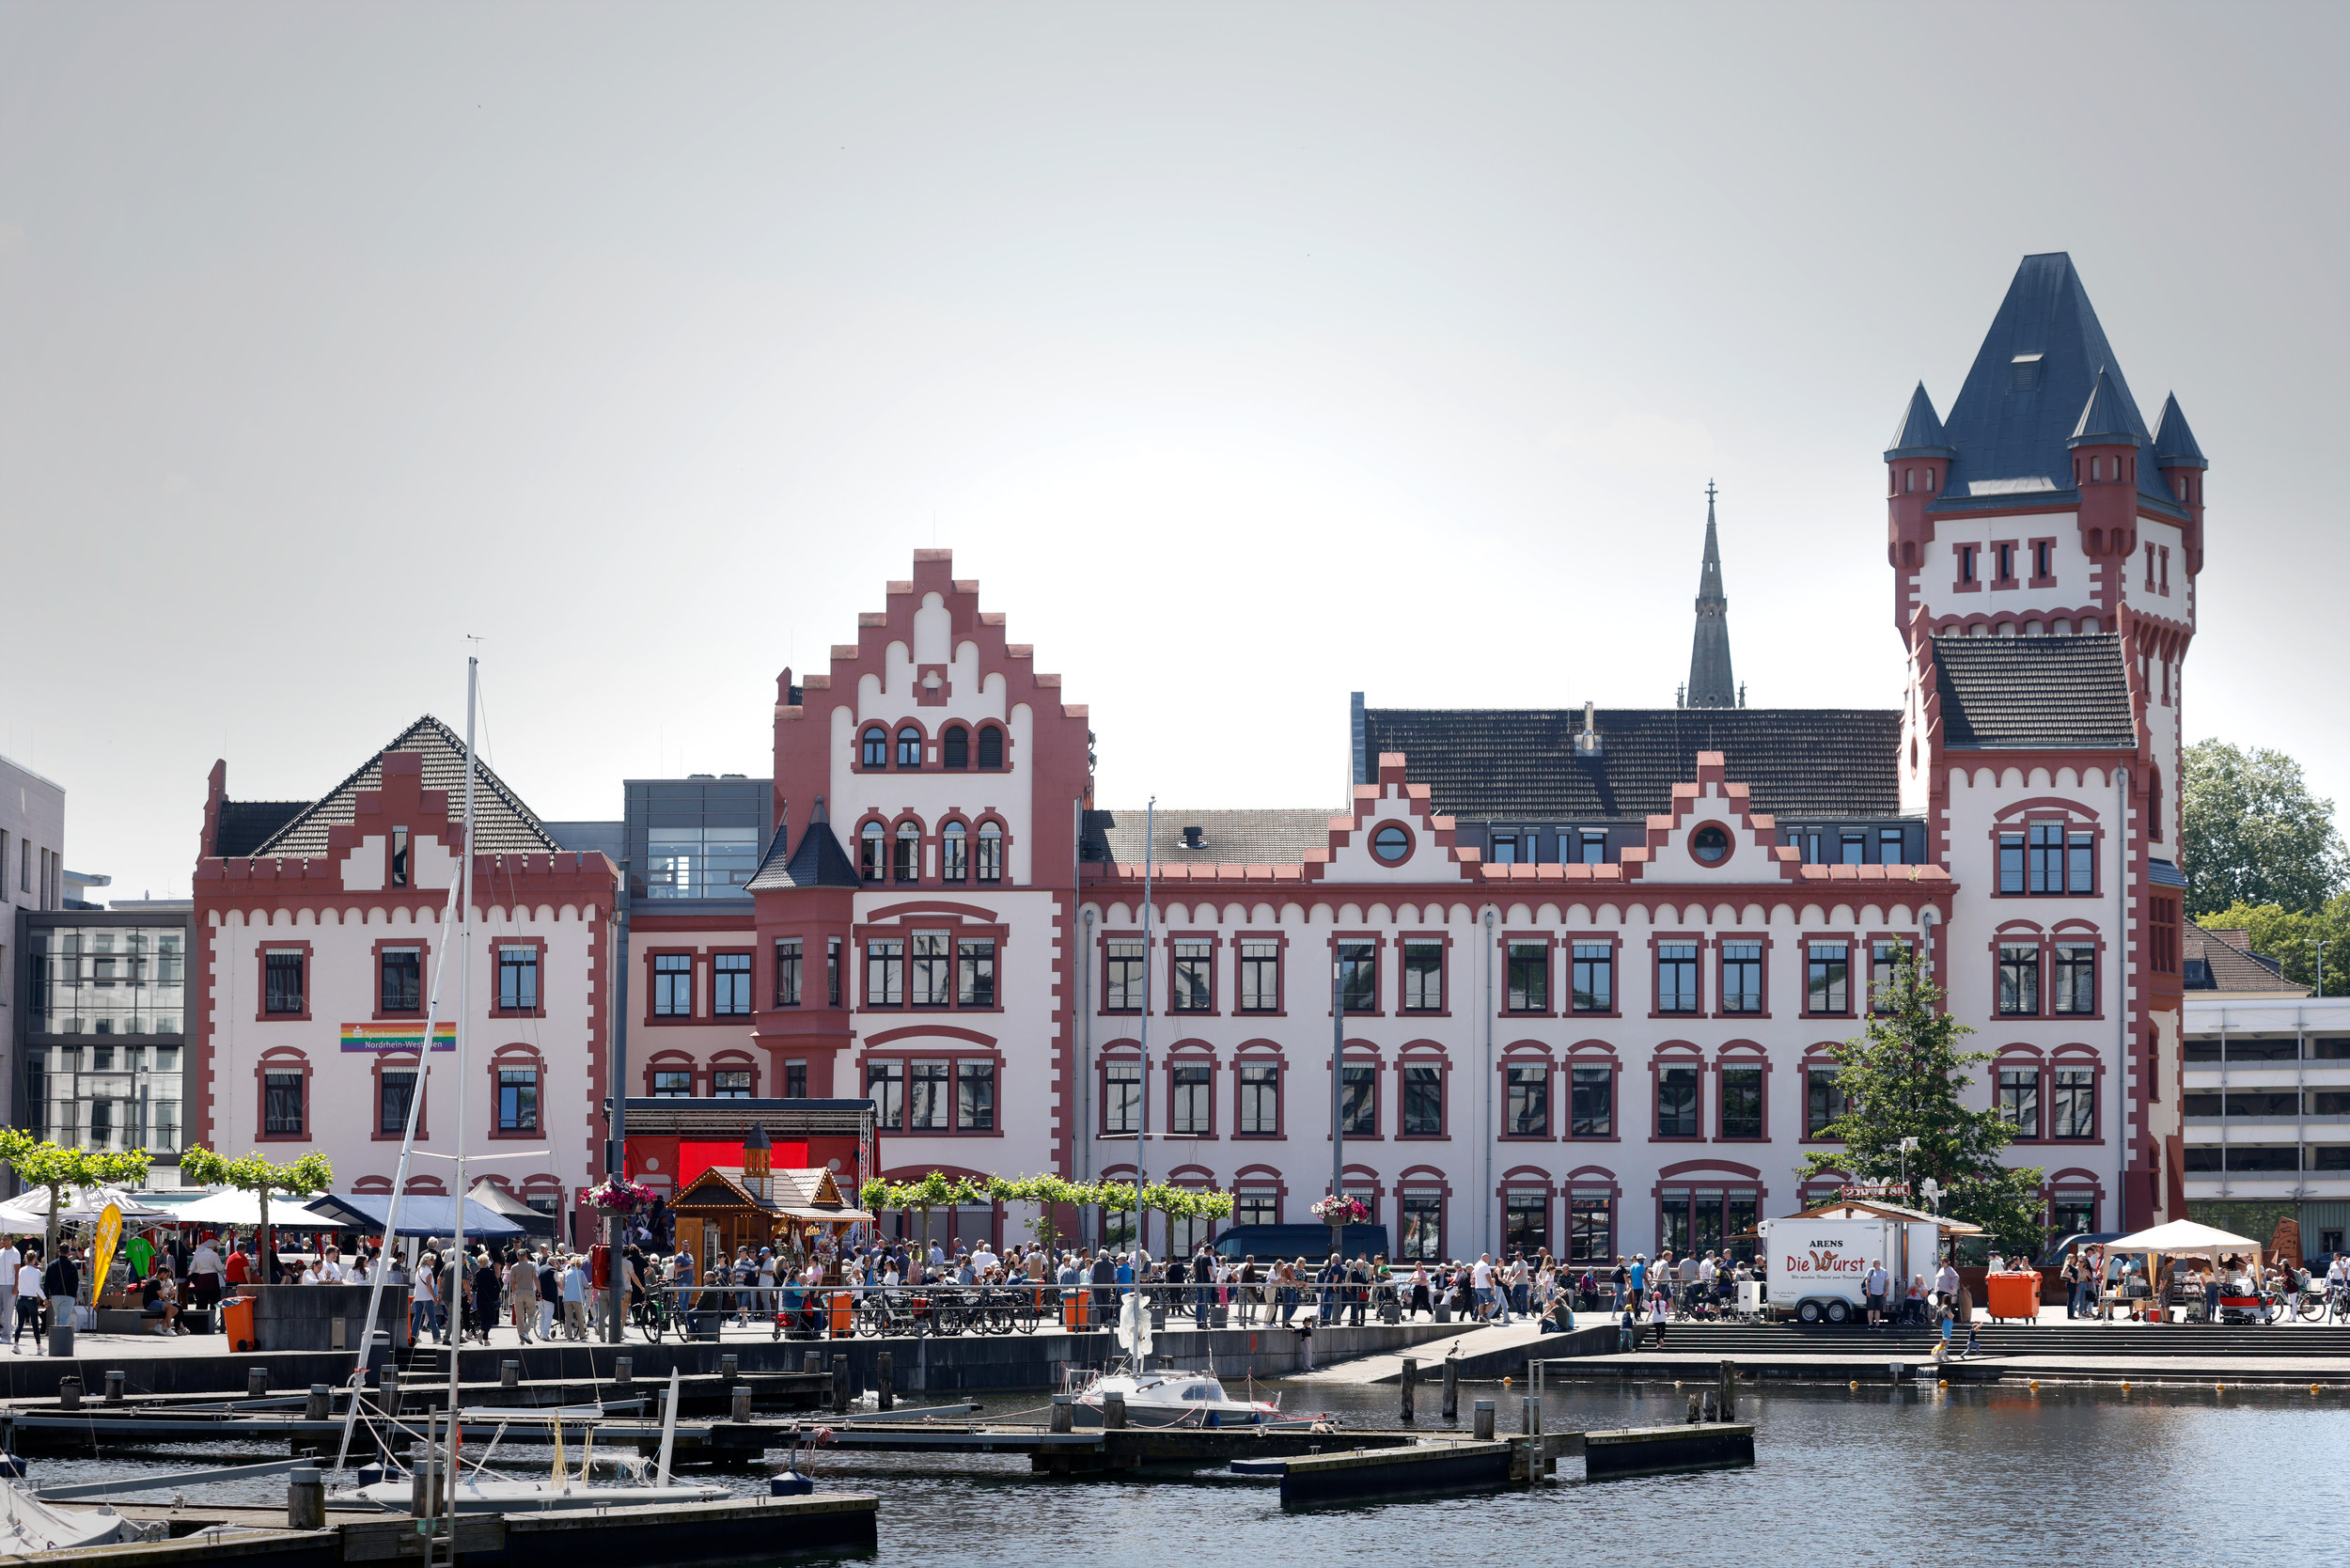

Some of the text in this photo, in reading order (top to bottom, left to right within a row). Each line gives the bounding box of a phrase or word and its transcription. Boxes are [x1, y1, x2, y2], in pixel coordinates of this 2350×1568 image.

[365, 1030, 444, 1039] Sparkassenakadmie
[1787, 1249, 1866, 1272] Die Wurst
